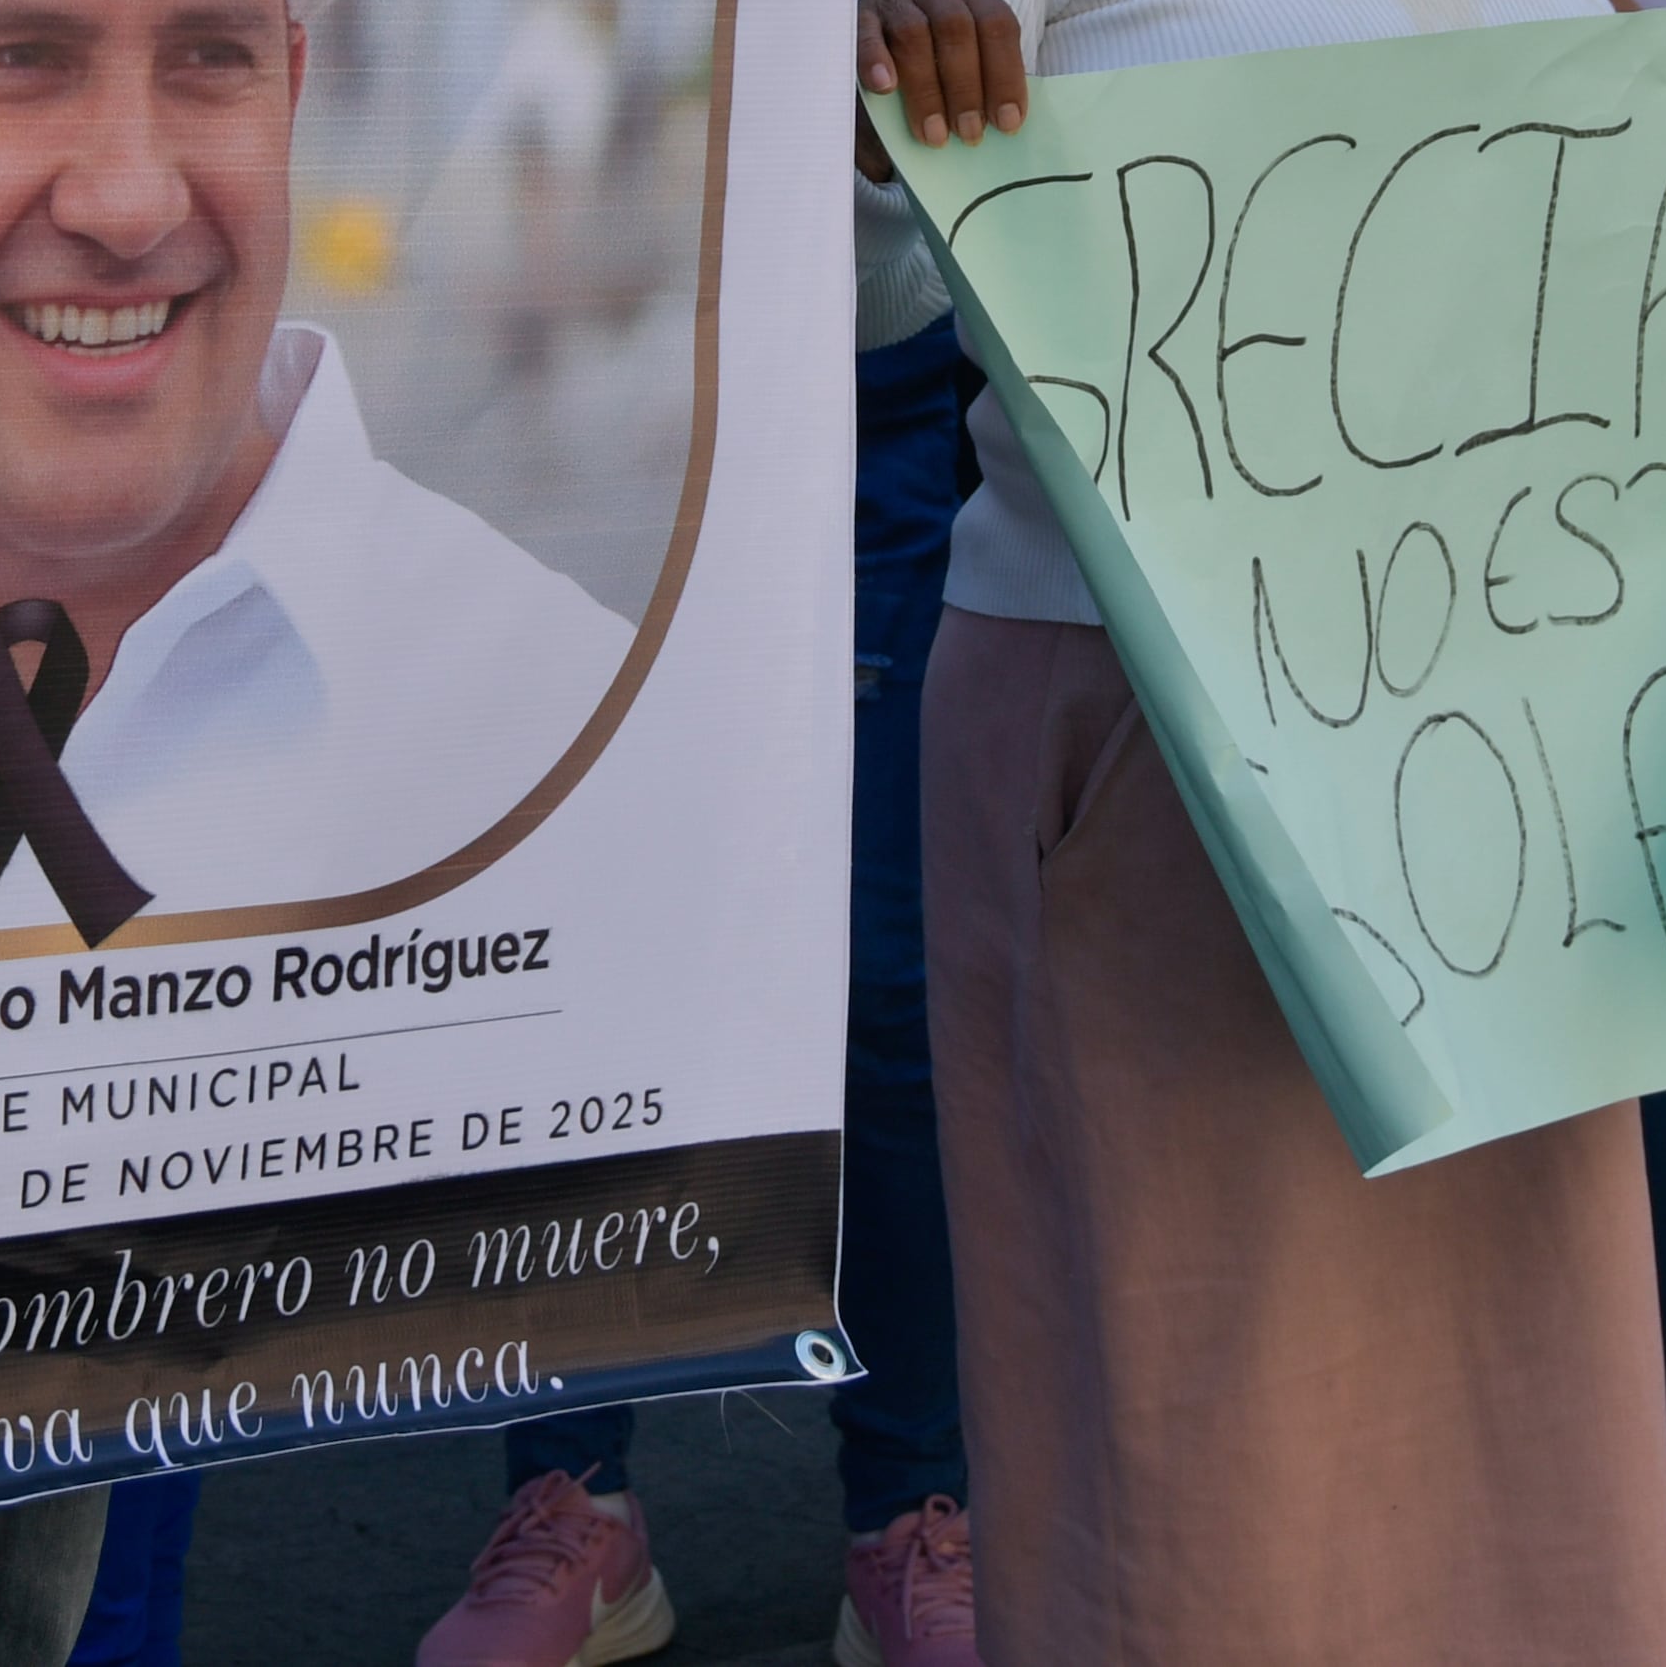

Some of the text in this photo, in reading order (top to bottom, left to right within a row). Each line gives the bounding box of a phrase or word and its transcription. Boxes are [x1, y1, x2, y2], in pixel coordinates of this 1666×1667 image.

[59, 965, 253, 1025] Manzo
[273, 928, 551, 1002] Rodríguez
[61, 1052, 360, 1126] MUNICIPAL
[21, 1163, 89, 1209] DE
[119, 1119, 434, 1196] NOVIEMBRE
[462, 1106, 523, 1151] DE
[549, 1088, 663, 1139] 2025
[345, 1239, 435, 1306] no
[467, 1202, 719, 1288] muere,
[125, 1382, 264, 1471] que
[291, 1341, 564, 1428] nunca.
